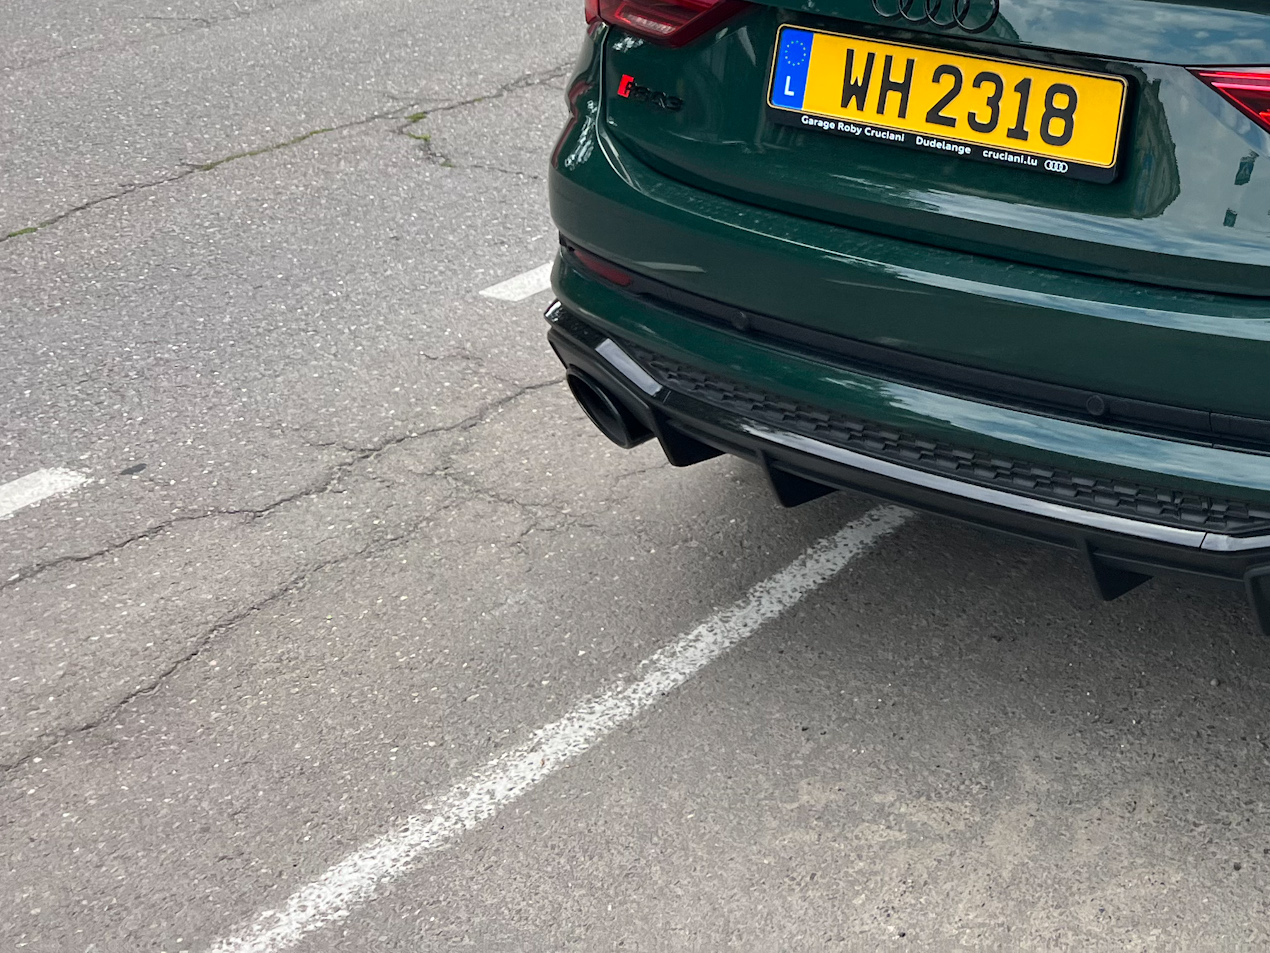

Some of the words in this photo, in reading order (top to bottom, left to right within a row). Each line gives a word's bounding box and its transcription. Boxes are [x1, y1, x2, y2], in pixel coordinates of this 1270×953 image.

[784, 76, 795, 97] L
[841, 48, 915, 119] WH
[925, 64, 1078, 147] 2318
[801, 115, 835, 131] Garage
[838, 122, 863, 136] Roby
[864, 127, 905, 142] Cruciani
[915, 136, 971, 155] Dudelange
[982, 149, 1038, 166] cruciani.lu
